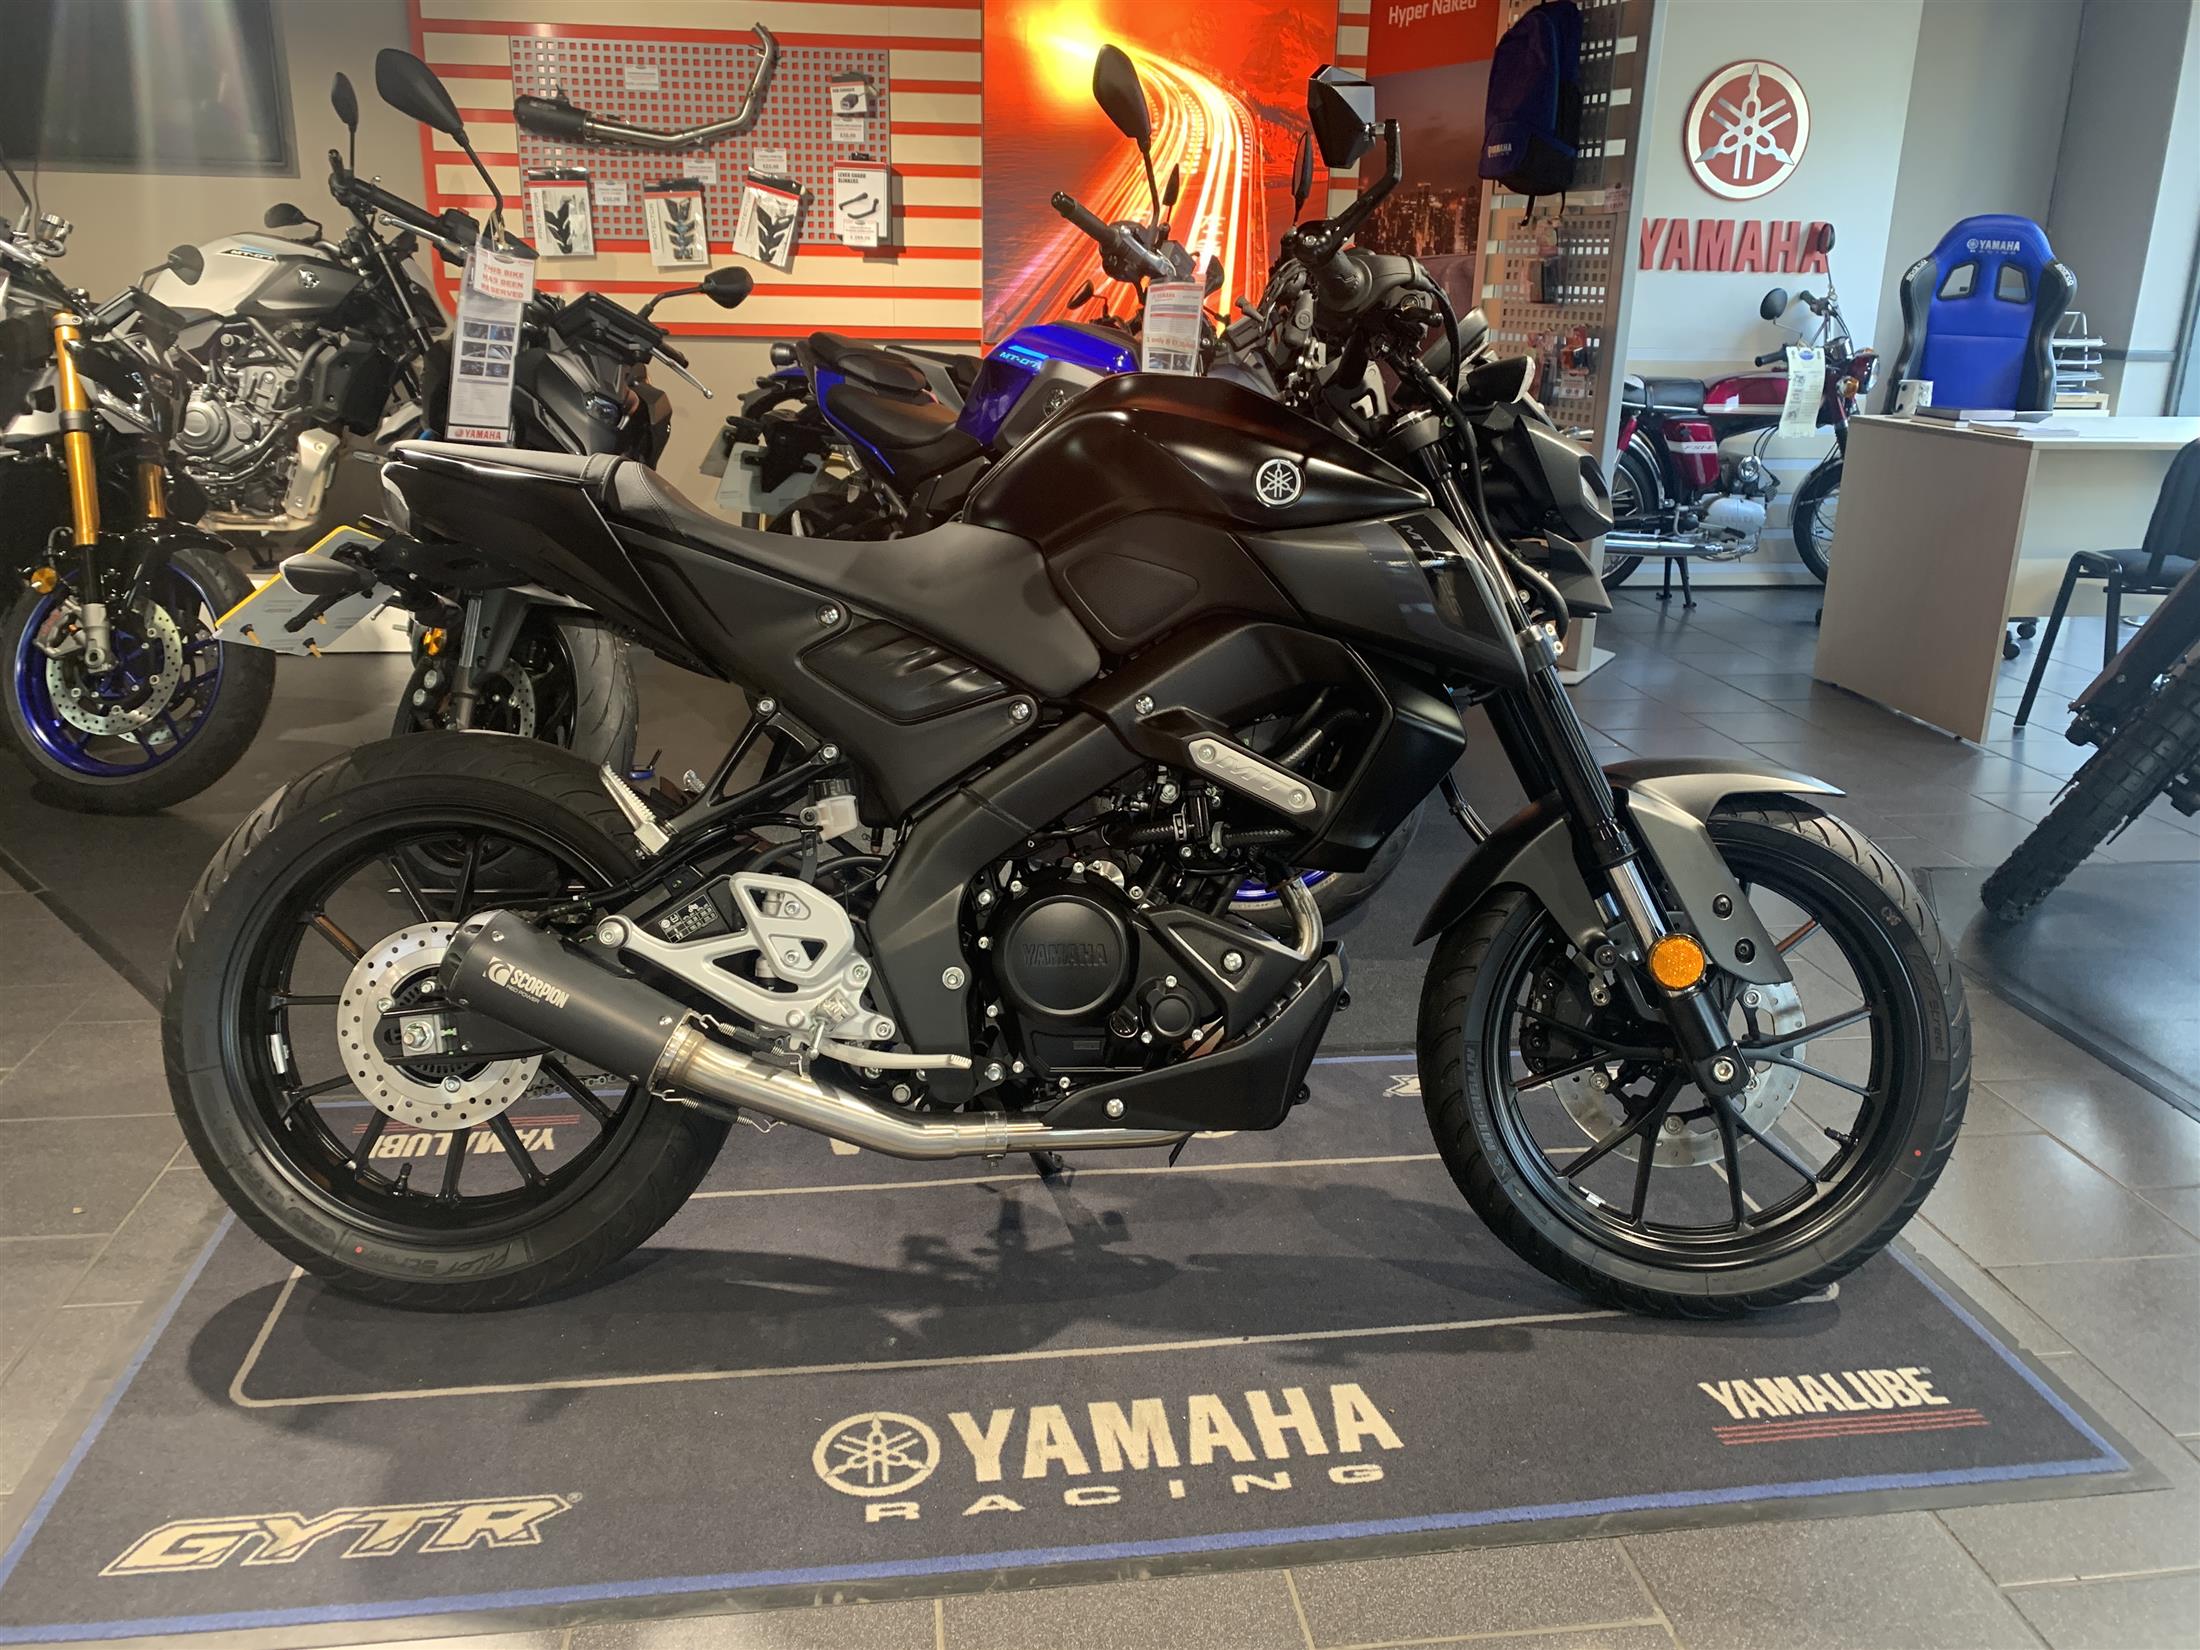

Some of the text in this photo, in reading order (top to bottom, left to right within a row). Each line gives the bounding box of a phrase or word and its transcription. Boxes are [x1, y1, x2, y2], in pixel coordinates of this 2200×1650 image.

[1388, 0, 1477, 28] Hyper Naked
[1638, 217, 1829, 273] YAMAHA
[1980, 240, 2020, 251] YAMAHA
[482, 273, 524, 289] HAS BEEN
[483, 263, 525, 278] THIS BIKE
[480, 283, 525, 299] RESERVED
[465, 428, 502, 441] YAMAHA
[1022, 943, 1108, 967] YAMAHA
[510, 969, 570, 1009] SCORPION
[519, 990, 541, 1004] POWER
[1466, 1046, 1497, 1150] MICHELIN
[368, 1127, 555, 1160] YAMLUB
[1697, 1366, 1951, 1420] YAMALUBE
[947, 1382, 1405, 1483] YAMAHA
[864, 1463, 1386, 1523] RACING
[98, 1494, 573, 1578] GYTR
